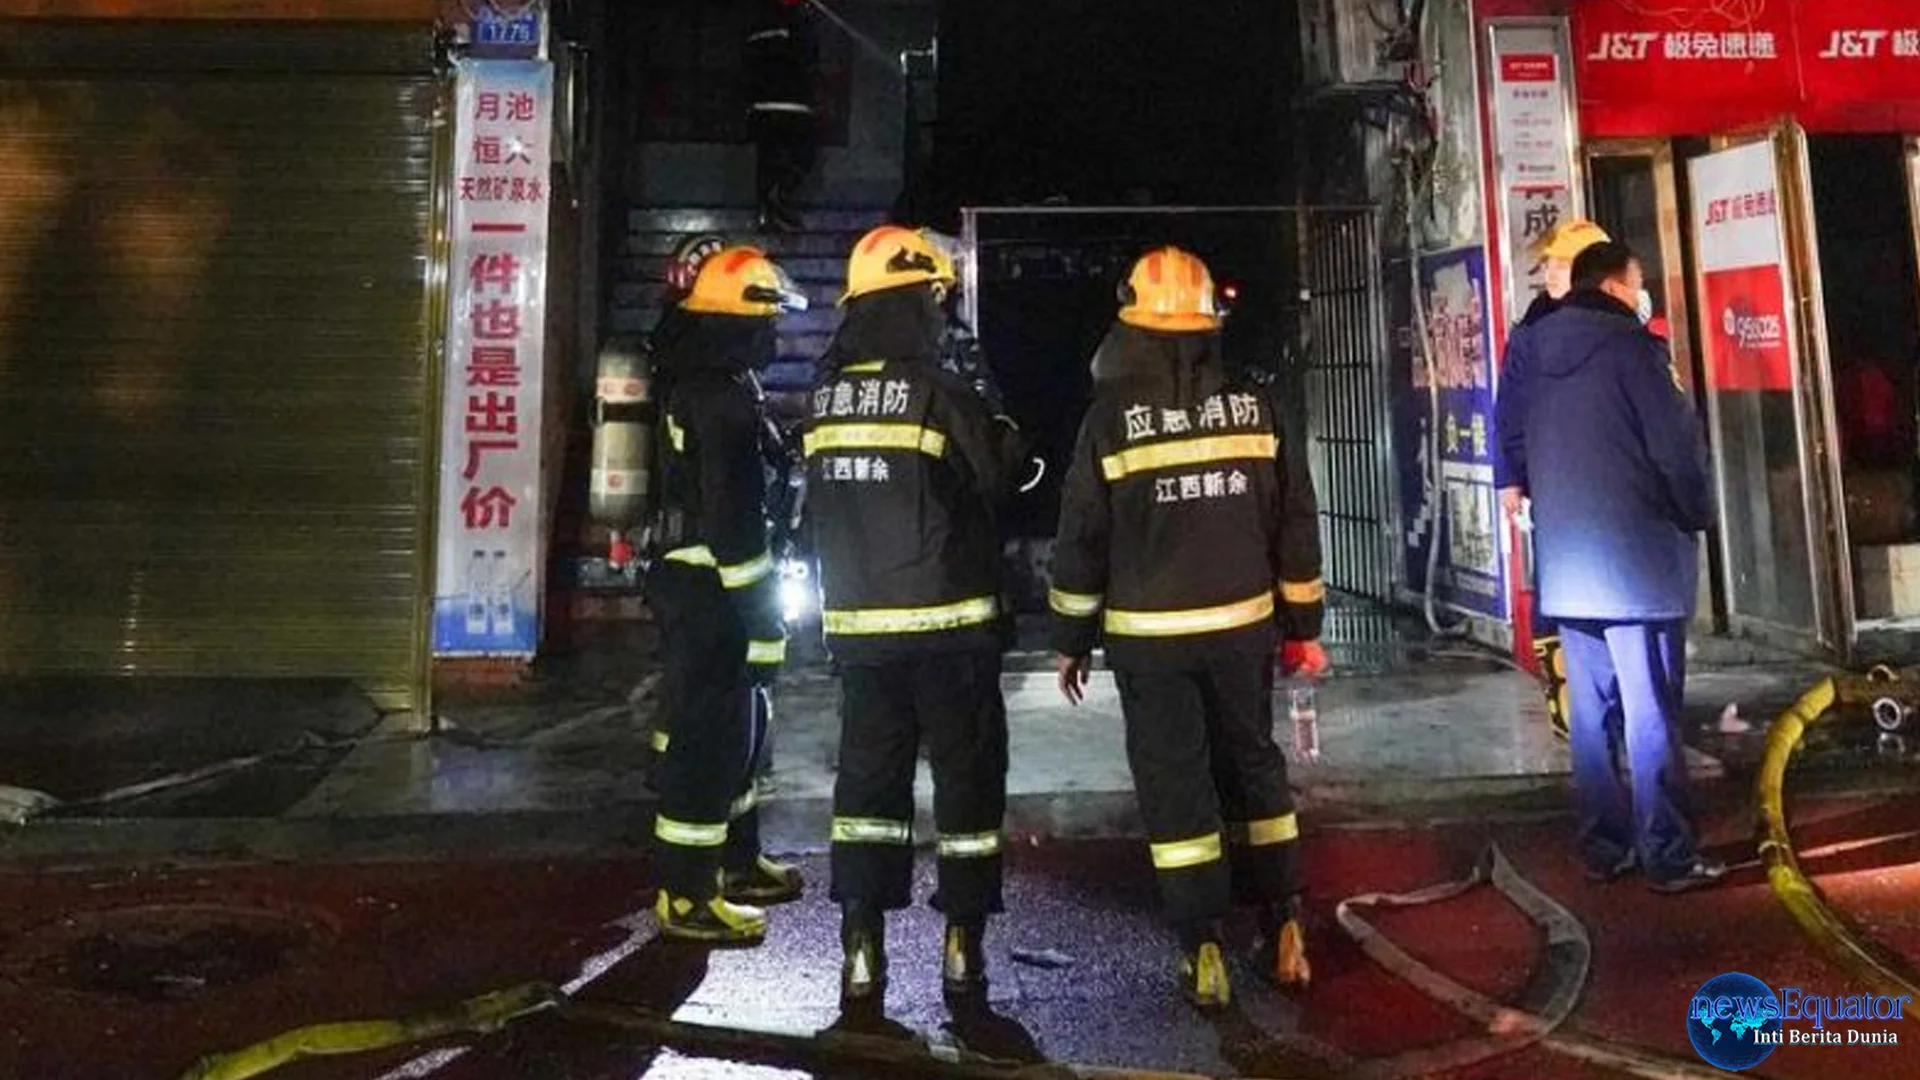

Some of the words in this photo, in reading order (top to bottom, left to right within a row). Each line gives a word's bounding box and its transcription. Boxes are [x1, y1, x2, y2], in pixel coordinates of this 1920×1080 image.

[1588, 32, 1659, 60] J&T
[1664, 31, 1777, 60] 极兔速递
[1819, 30, 1889, 58] J&T
[475, 92, 534, 121] 月池
[460, 177, 542, 201] 天然矿泉水
[1705, 199, 1730, 225] J&T
[460, 223, 525, 530] 一件也是出厂价
[813, 379, 910, 418] 应急消防
[1124, 393, 1260, 440] 应急消防
[822, 457, 889, 481] 江西新余
[1155, 469, 1248, 502] 江西新余
